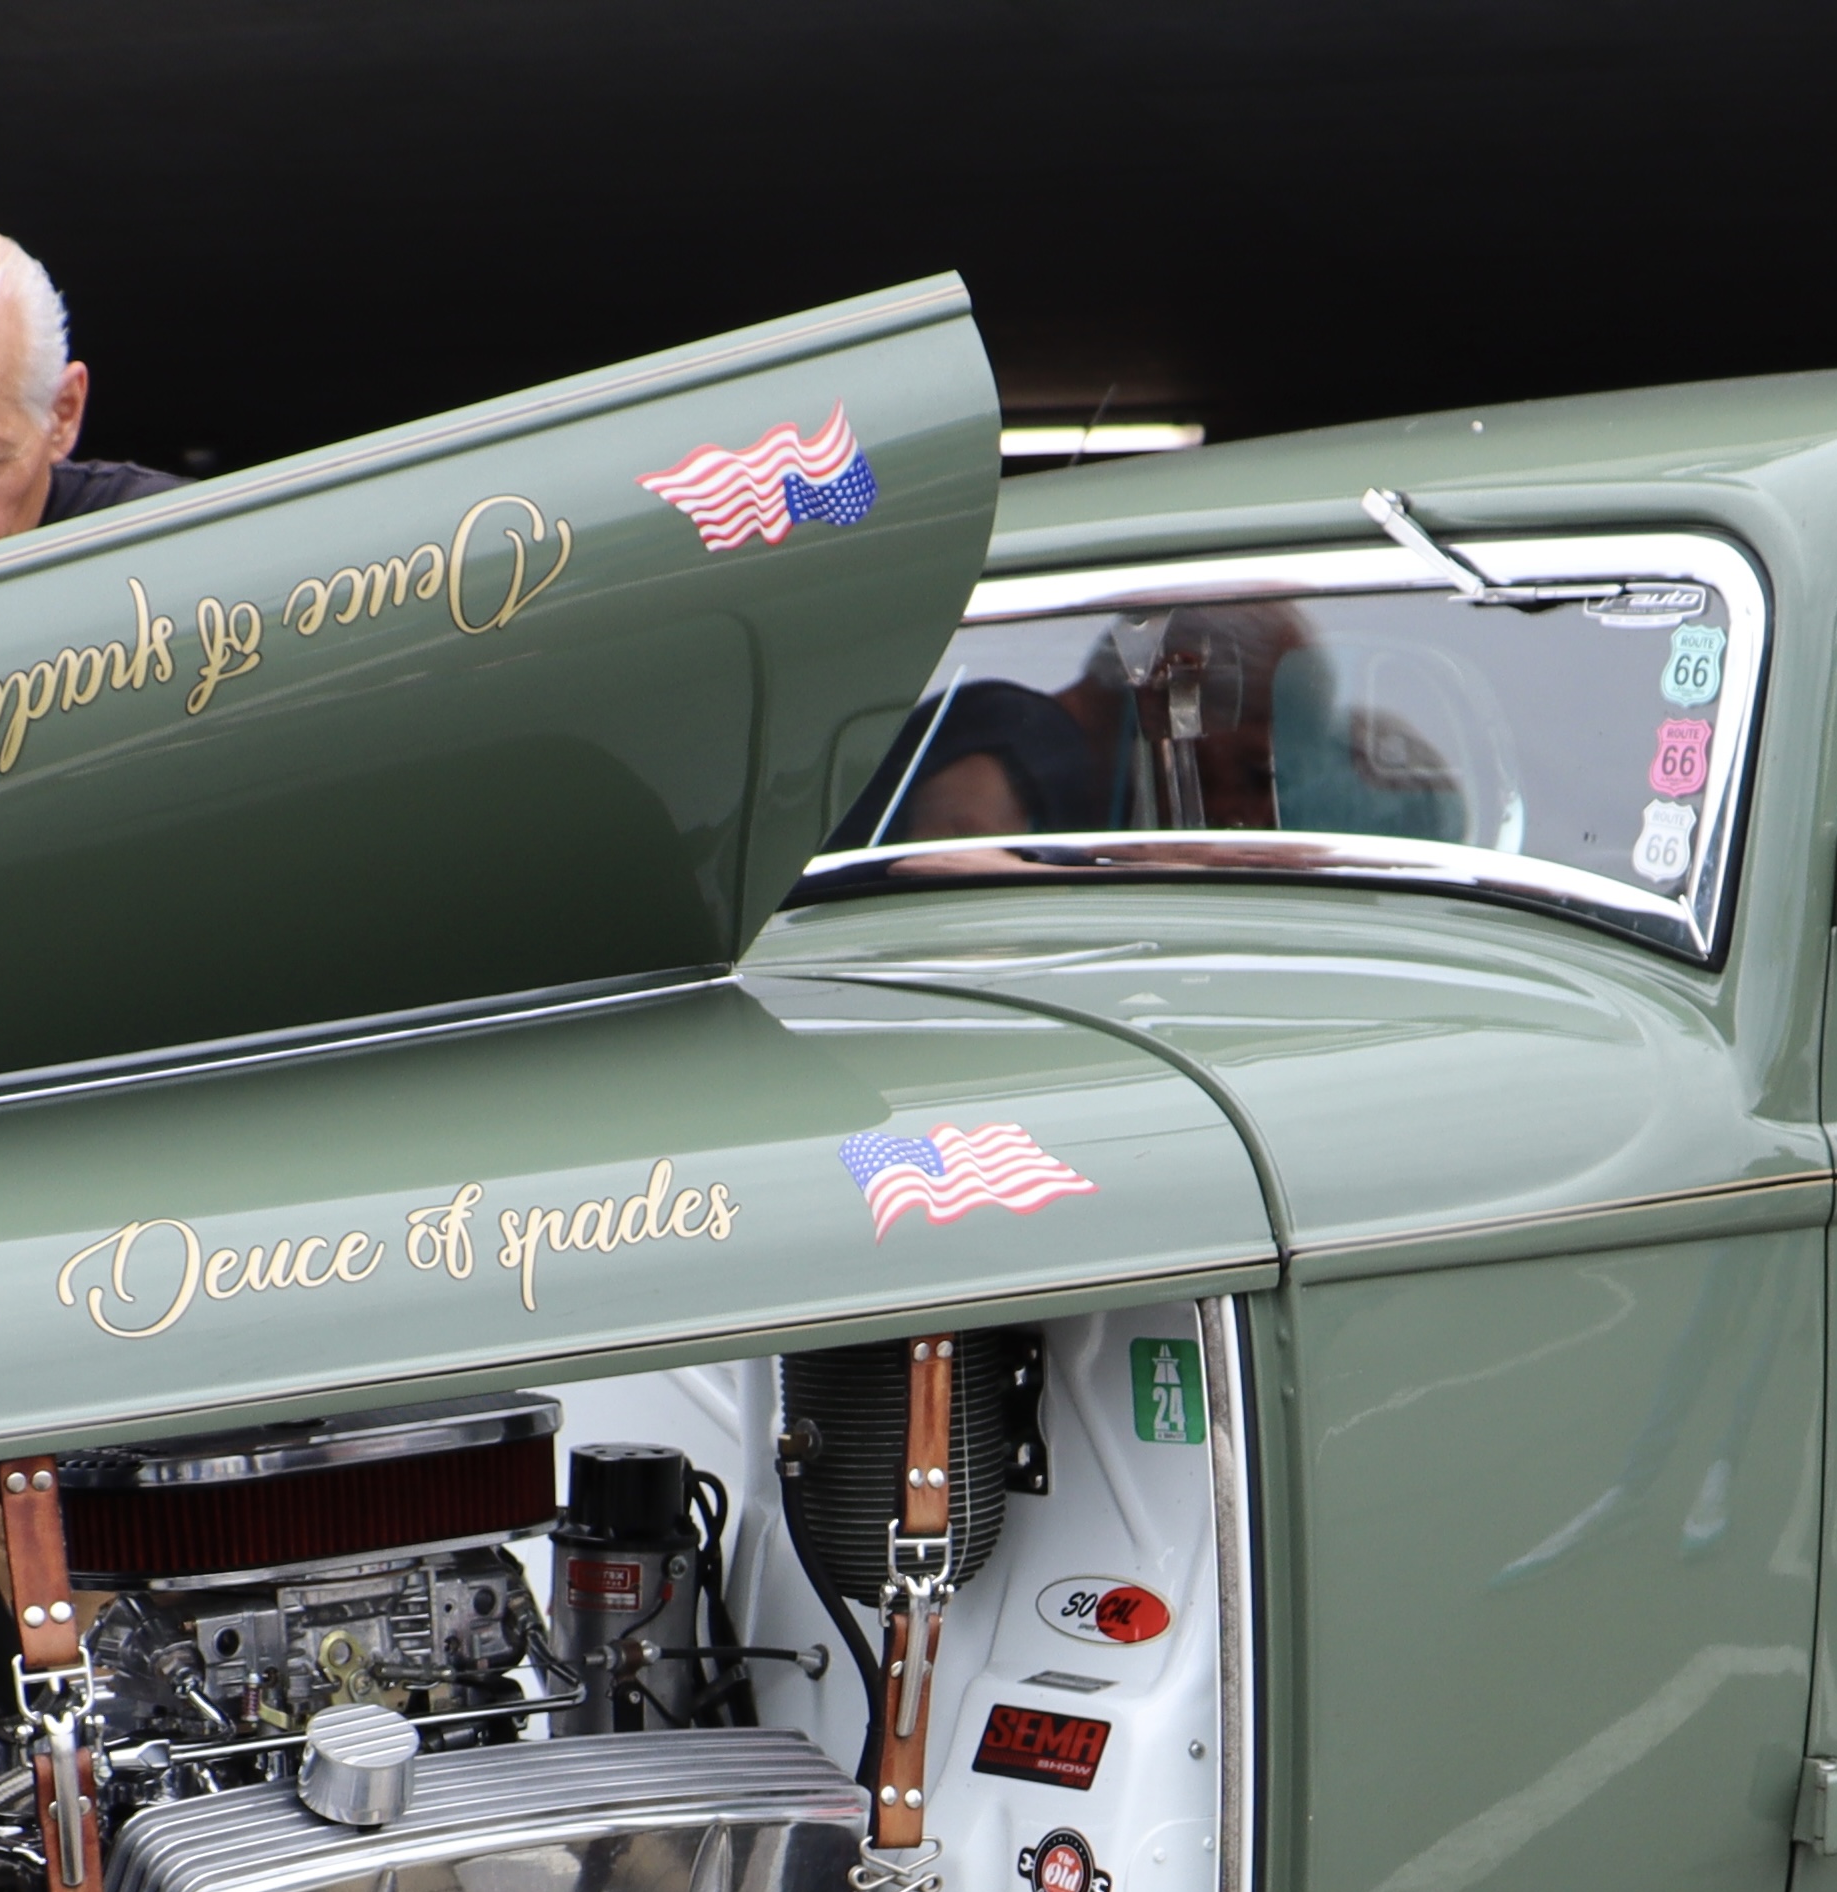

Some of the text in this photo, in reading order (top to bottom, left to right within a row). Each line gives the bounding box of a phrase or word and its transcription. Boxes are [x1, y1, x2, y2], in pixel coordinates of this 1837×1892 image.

[283, 494, 573, 634] Deuce
[186, 597, 262, 714] of
[1680, 634, 1715, 650] ROUTE
[1674, 653, 1709, 688] 66
[1667, 728, 1699, 740] ROUTE
[1661, 745, 1695, 776] 66
[1652, 810, 1685, 826] ROUTE
[1645, 834, 1679, 866] 66
[57, 1158, 740, 1339] Deuce of spades
[1153, 1386, 1185, 1431] 24
[984, 1705, 1108, 1763] SEMA
[1037, 1759, 1093, 1775] SHOW
[1044, 1862, 1080, 1891] Old
